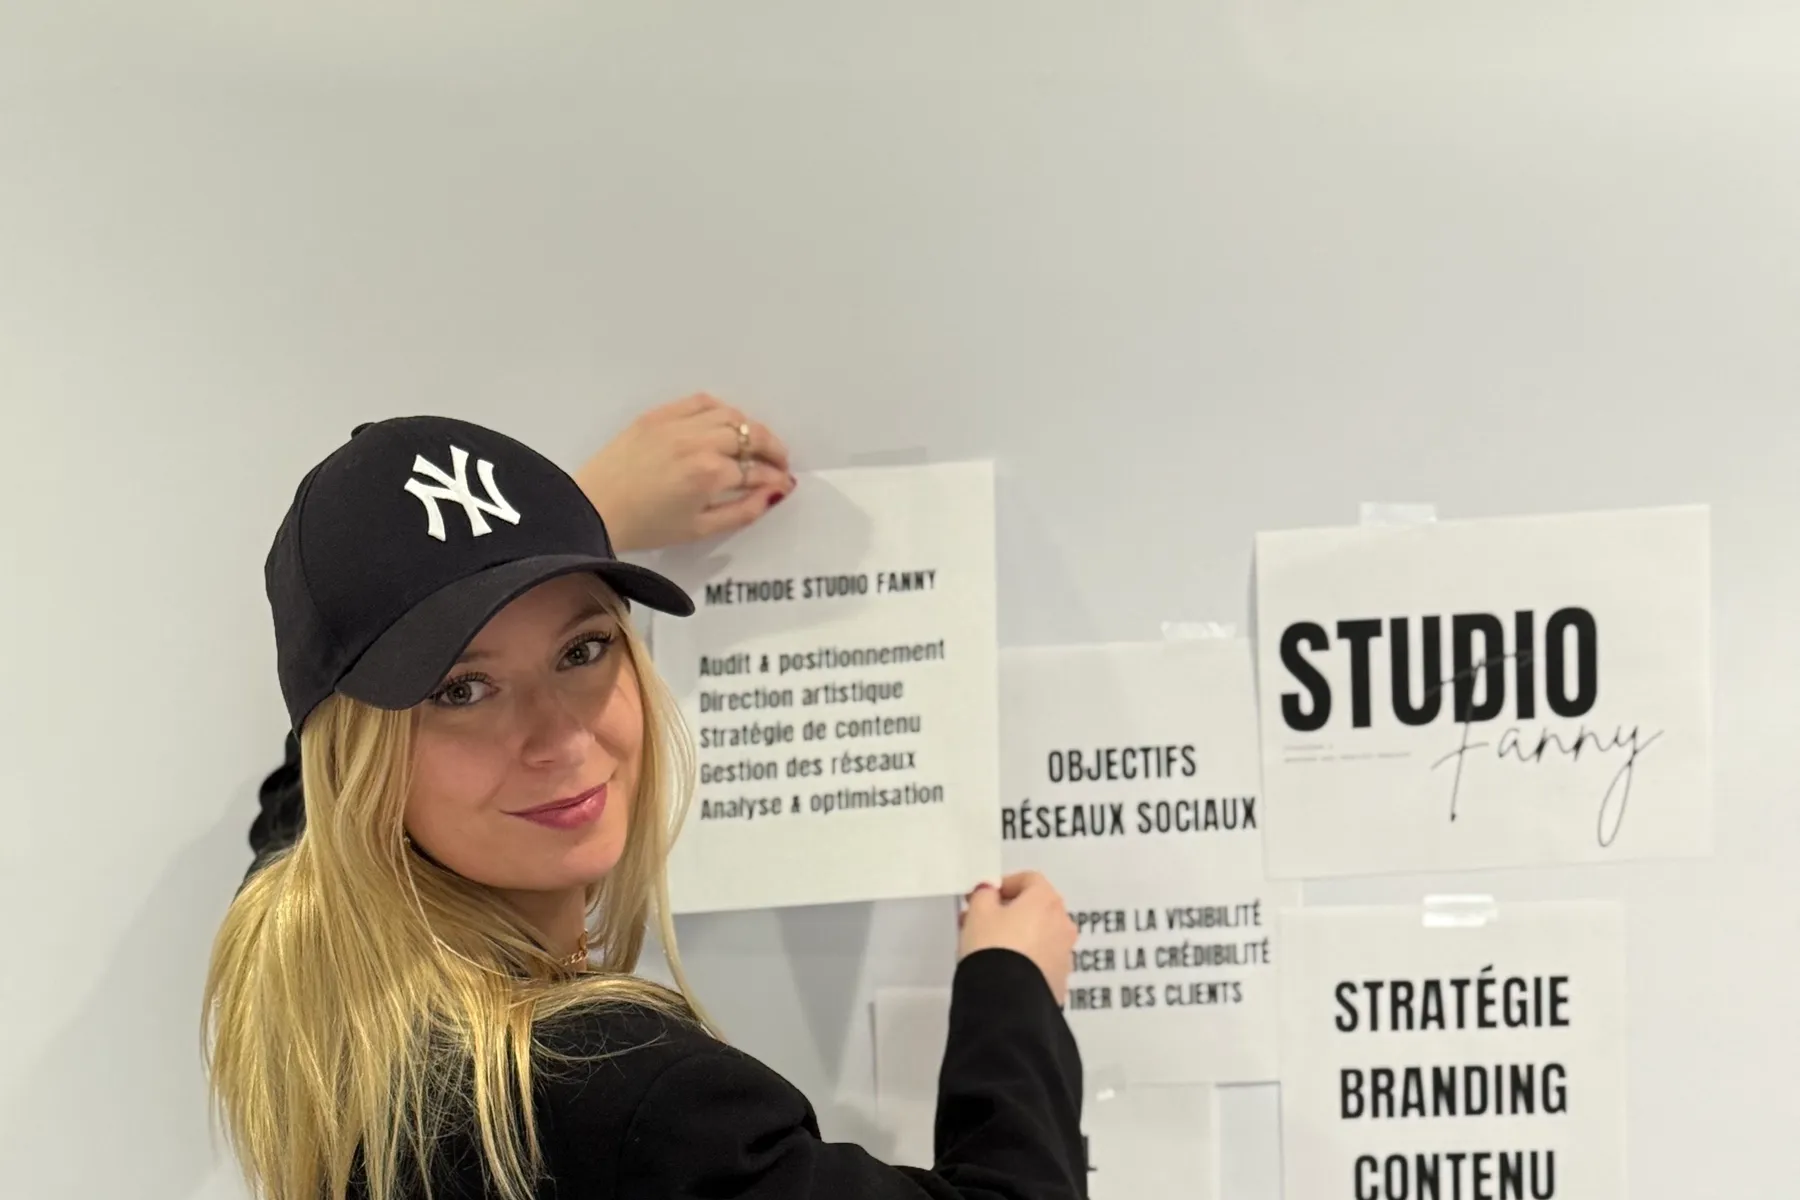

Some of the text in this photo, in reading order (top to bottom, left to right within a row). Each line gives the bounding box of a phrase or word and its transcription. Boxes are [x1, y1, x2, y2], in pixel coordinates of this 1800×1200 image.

[705, 570, 936, 606] MÉTHODE STUDIO FANNY
[700, 639, 946, 678] Audit & positionnement
[1279, 606, 1598, 732] STUDIO
[700, 679, 904, 713] Direction artistique
[700, 714, 921, 748] Stratégie de contenu
[701, 750, 916, 784] Gestion des réseaux
[1048, 745, 1197, 783] OBJECTIFS
[700, 782, 945, 821] Analyse & optimisation
[1001, 797, 1258, 840] RÉSEAUX SOCIAUX
[1134, 908, 1157, 932] LA
[1165, 899, 1262, 930] VISIBILITÉ
[1124, 948, 1147, 969] LA
[1155, 937, 1271, 968] CRÉDIBILITÉ
[1121, 985, 1156, 1007] DES
[1165, 982, 1242, 1006] CLIENTS
[1334, 964, 1570, 1033] STRATÉGIE
[1339, 1062, 1568, 1119] BRANDING
